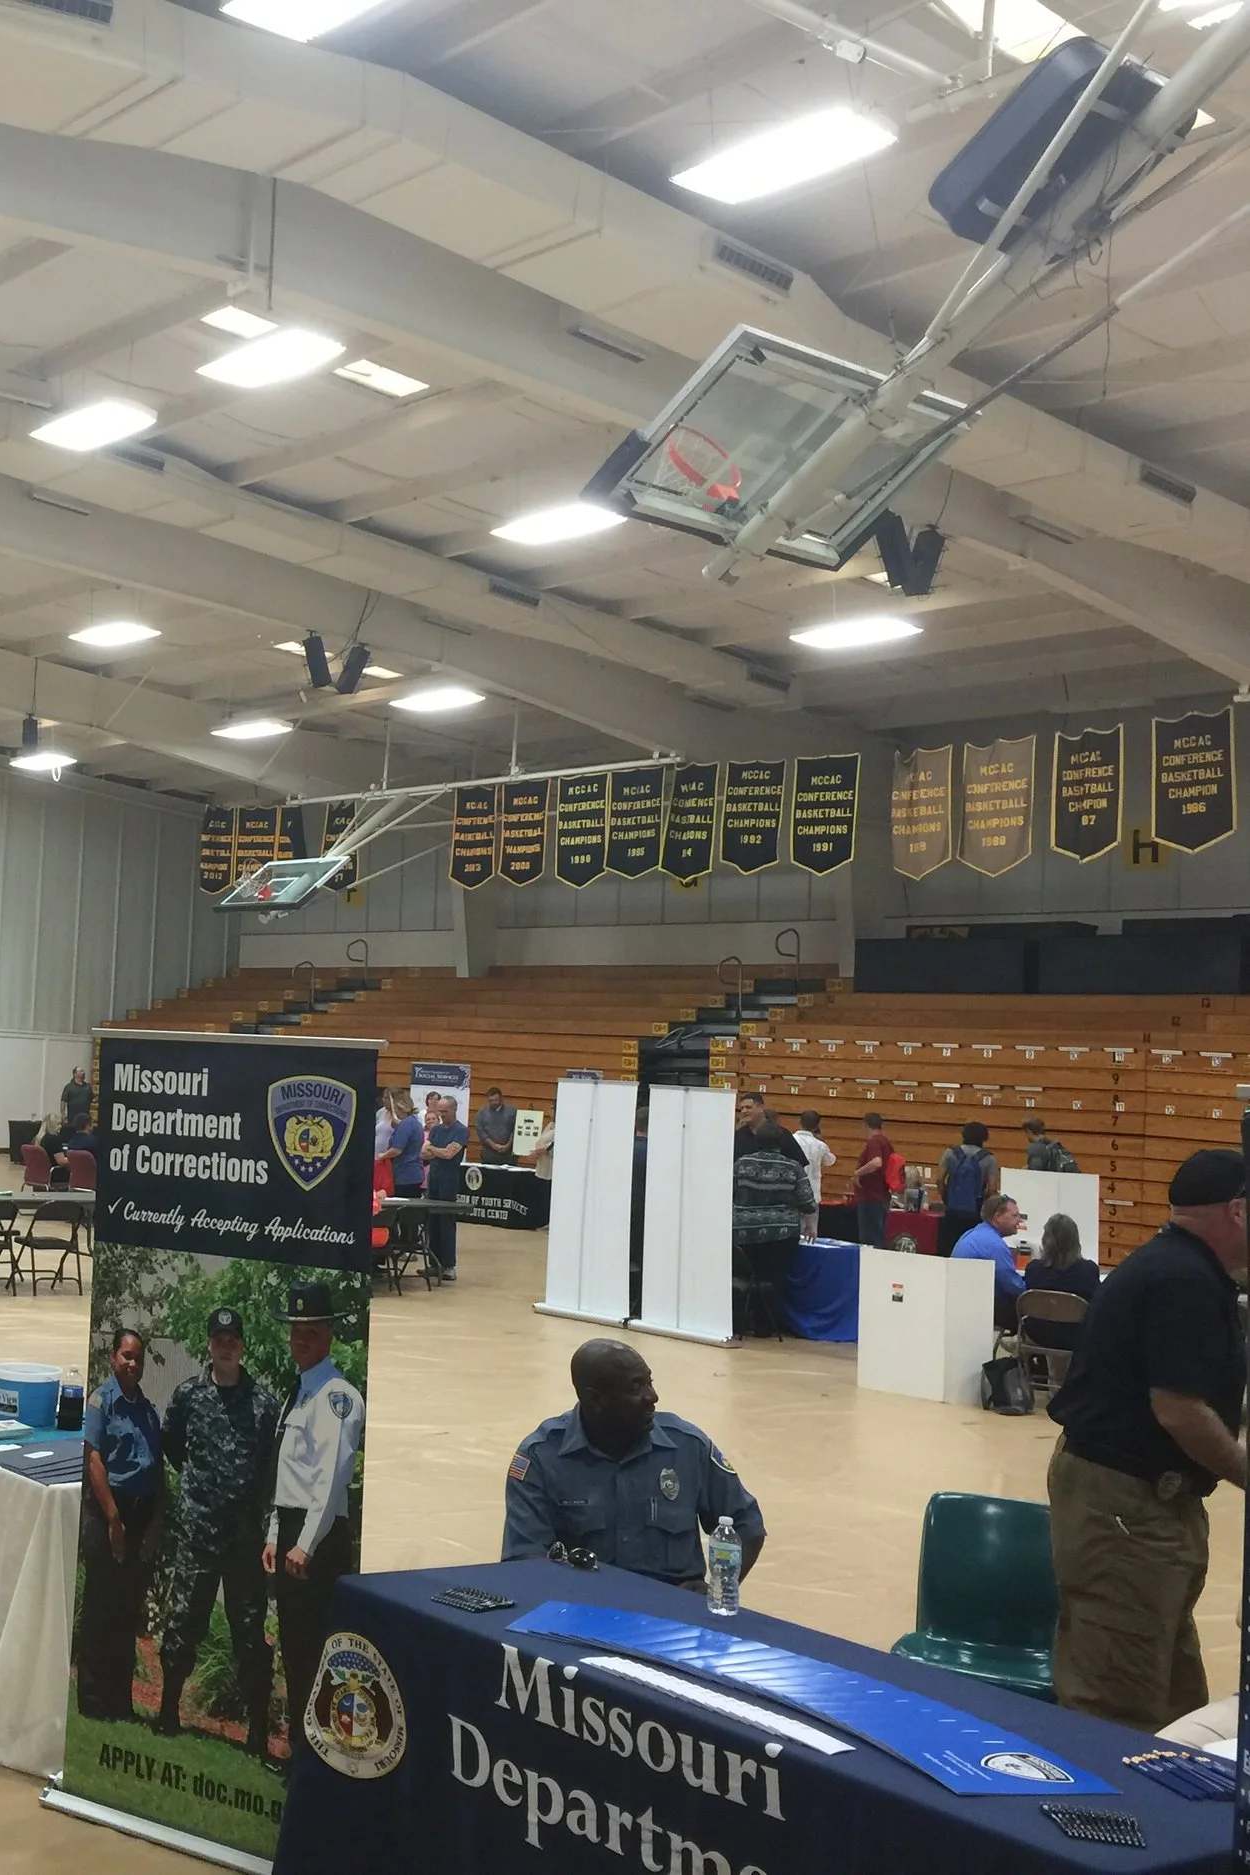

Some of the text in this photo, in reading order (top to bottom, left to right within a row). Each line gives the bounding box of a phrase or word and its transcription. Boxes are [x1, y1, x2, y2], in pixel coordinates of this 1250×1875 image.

[1174, 735, 1212, 749] MCCAC
[1162, 749, 1224, 766] CONFERENCE
[741, 770, 771, 780] MCCAC
[811, 775, 842, 786] MCCAC
[1161, 767, 1224, 783] BASKETBALL
[728, 785, 782, 796] CONFERENCE
[797, 790, 853, 802] CONFERENCE
[1168, 784, 1217, 799] CHAMPION
[559, 800, 605, 812] CONFERENCE
[612, 798, 661, 810] CONFERENCE
[726, 802, 780, 813] BASKETBALL
[795, 808, 852, 818] BASKETBALL
[559, 818, 604, 829] BASKETBALL
[611, 814, 659, 826] BASKETBALL
[727, 818, 777, 828] CHAMPIONS
[967, 816, 1024, 829] CHAMPIONS
[612, 829, 655, 840] CHAMPIONS
[797, 825, 848, 835] CHAMPIONS
[560, 835, 602, 845] CHAMPIONS
[740, 835, 762, 844] 1992
[813, 842, 833, 852] 1991
[114, 1063, 208, 1096] Missouri
[1112, 1073, 1119, 1085] 9
[281, 1083, 345, 1106] MISSOURI
[112, 1103, 241, 1141] Department
[1111, 1115, 1119, 1127] 7
[1111, 1140, 1119, 1150] 6
[109, 1144, 268, 1185] of Corrections
[1110, 1161, 1117, 1172] 5
[1107, 1182, 1116, 1193] 4
[123, 1200, 356, 1245] Currently Accepting Applications
[1108, 1226, 1115, 1238] 2
[1107, 1248, 1111, 1258] 1
[331, 1638, 343, 1649] OF
[348, 1638, 369, 1653] THE
[374, 1727, 404, 1772] MISSOURI
[494, 1642, 786, 1822] Missouri
[99, 1743, 157, 1782] APPLY
[161, 1762, 187, 1792] AT:
[448, 1713, 768, 1875] Departm
